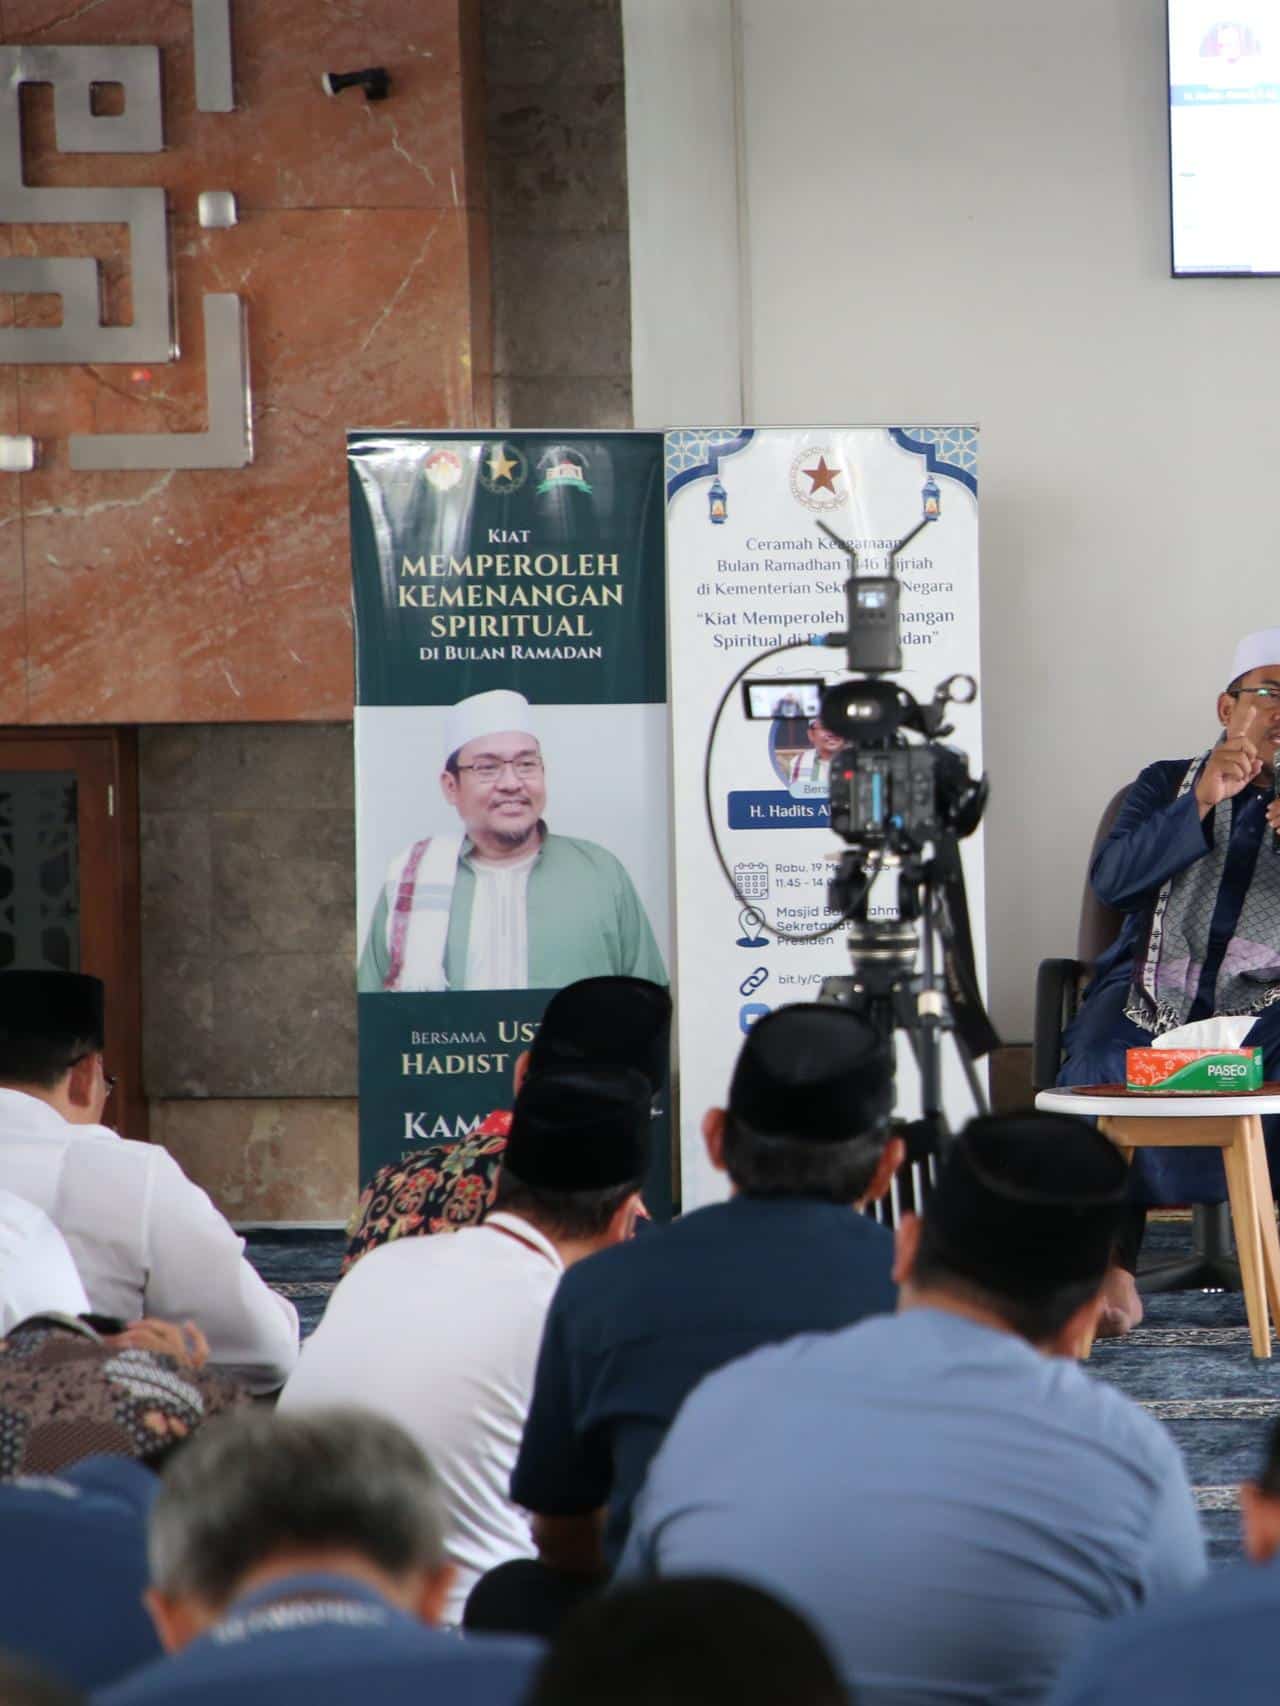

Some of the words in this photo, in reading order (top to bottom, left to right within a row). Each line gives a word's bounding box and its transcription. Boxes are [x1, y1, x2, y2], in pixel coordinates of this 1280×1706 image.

[746, 537, 813, 551] Ceramah
[401, 553, 619, 577] MEMPEROLEH
[717, 560, 759, 573] Bulan
[764, 558, 841, 572] Ramadhan
[398, 583, 624, 608] KEMENANGAN
[696, 583, 710, 596] di
[715, 582, 811, 595] Kementerian
[901, 580, 953, 597] Negara
[431, 614, 592, 638] SPIRITUAL
[743, 610, 844, 629] Memperoleh
[713, 634, 783, 650] Spiritual
[750, 804, 765, 818] H.
[769, 803, 815, 818] Hadits
[812, 862, 822, 873] 19
[775, 878, 801, 889] 11.45
[777, 907, 819, 920] Masjid
[402, 1053, 509, 1075] HADIST
[1208, 1065, 1247, 1077] PASEO
[404, 1112, 486, 1138] KAM
